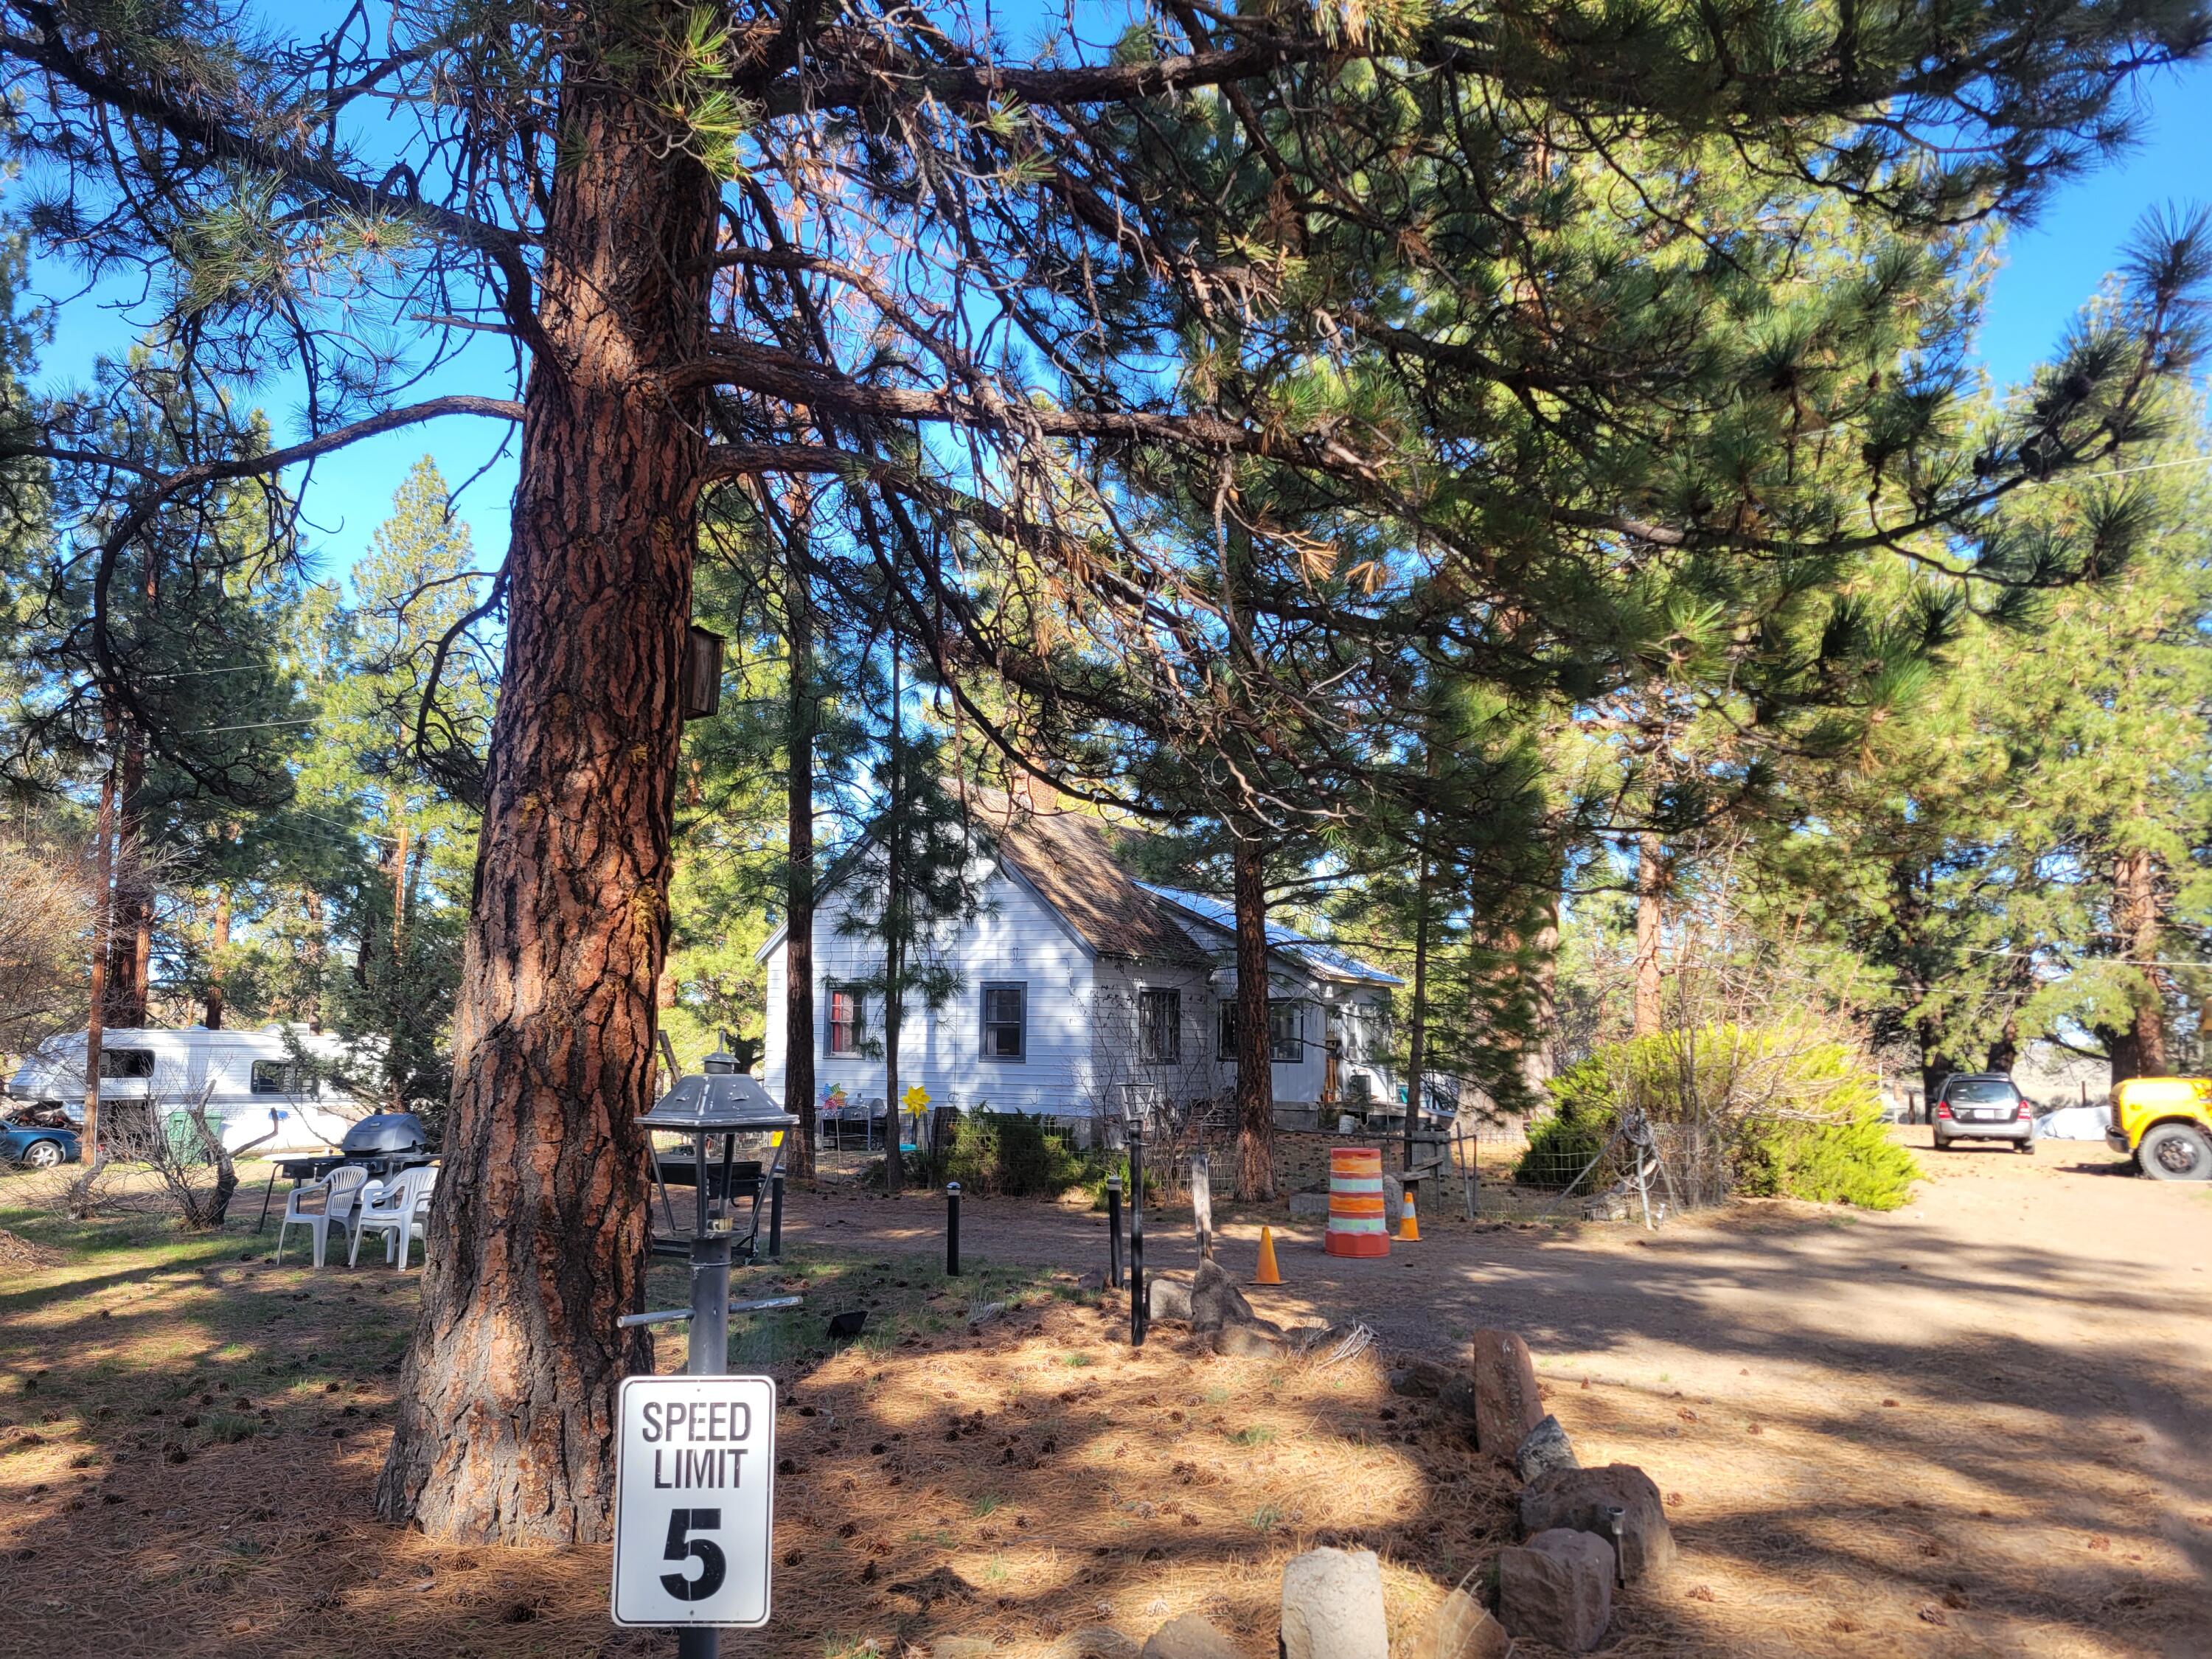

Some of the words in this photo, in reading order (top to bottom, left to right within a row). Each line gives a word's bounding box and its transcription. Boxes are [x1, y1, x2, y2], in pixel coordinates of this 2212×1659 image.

[642, 1402, 751, 1442] SPEED
[654, 1449, 748, 1489] LIMIT
[659, 1508, 727, 1601] 5
